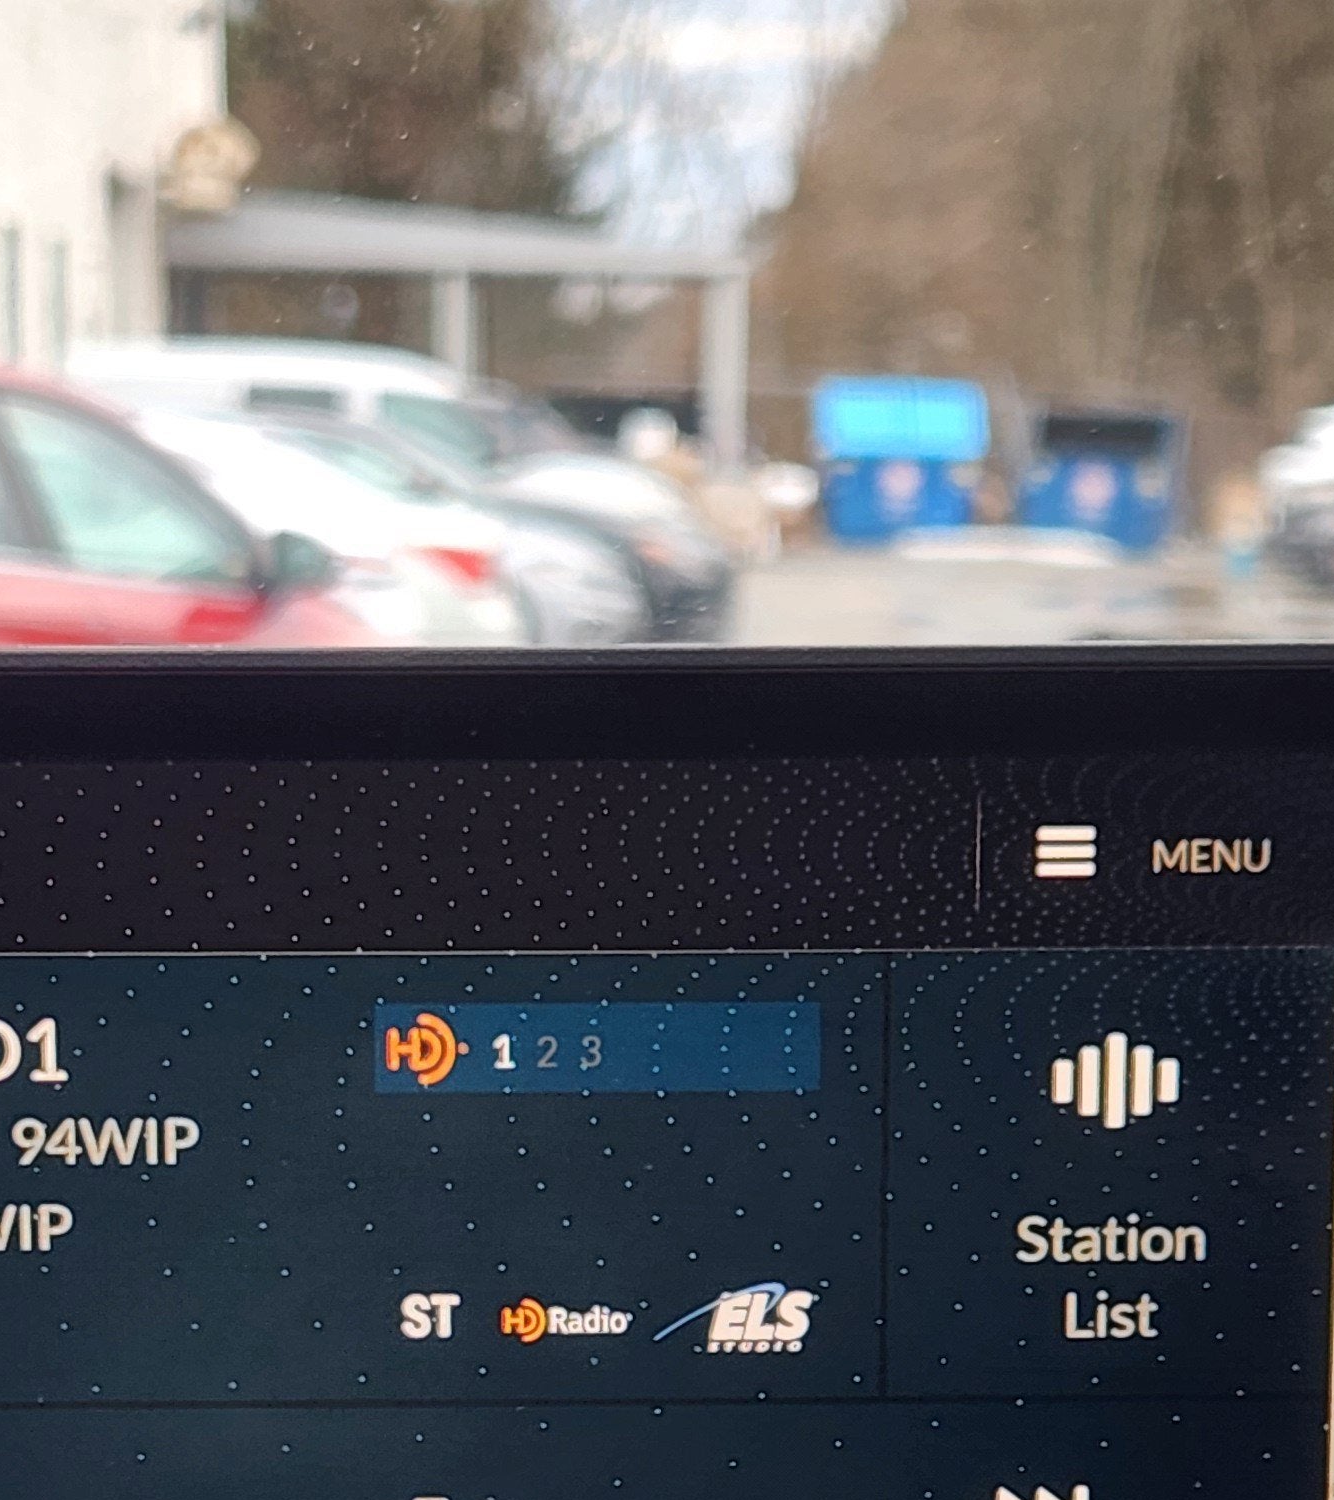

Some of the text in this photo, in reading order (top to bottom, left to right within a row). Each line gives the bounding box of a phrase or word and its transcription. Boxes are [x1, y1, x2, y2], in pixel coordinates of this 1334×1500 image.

[1151, 838, 1272, 873] MENU
[492, 1033, 603, 1070] 1 2 3
[10, 1117, 200, 1168] 94WIP
[1016, 1214, 1207, 1263] Station
[400, 1292, 462, 1340] ST
[707, 1288, 817, 1342] ELS
[1066, 1292, 1158, 1339] List
[706, 1340, 803, 1354] STUDIO
